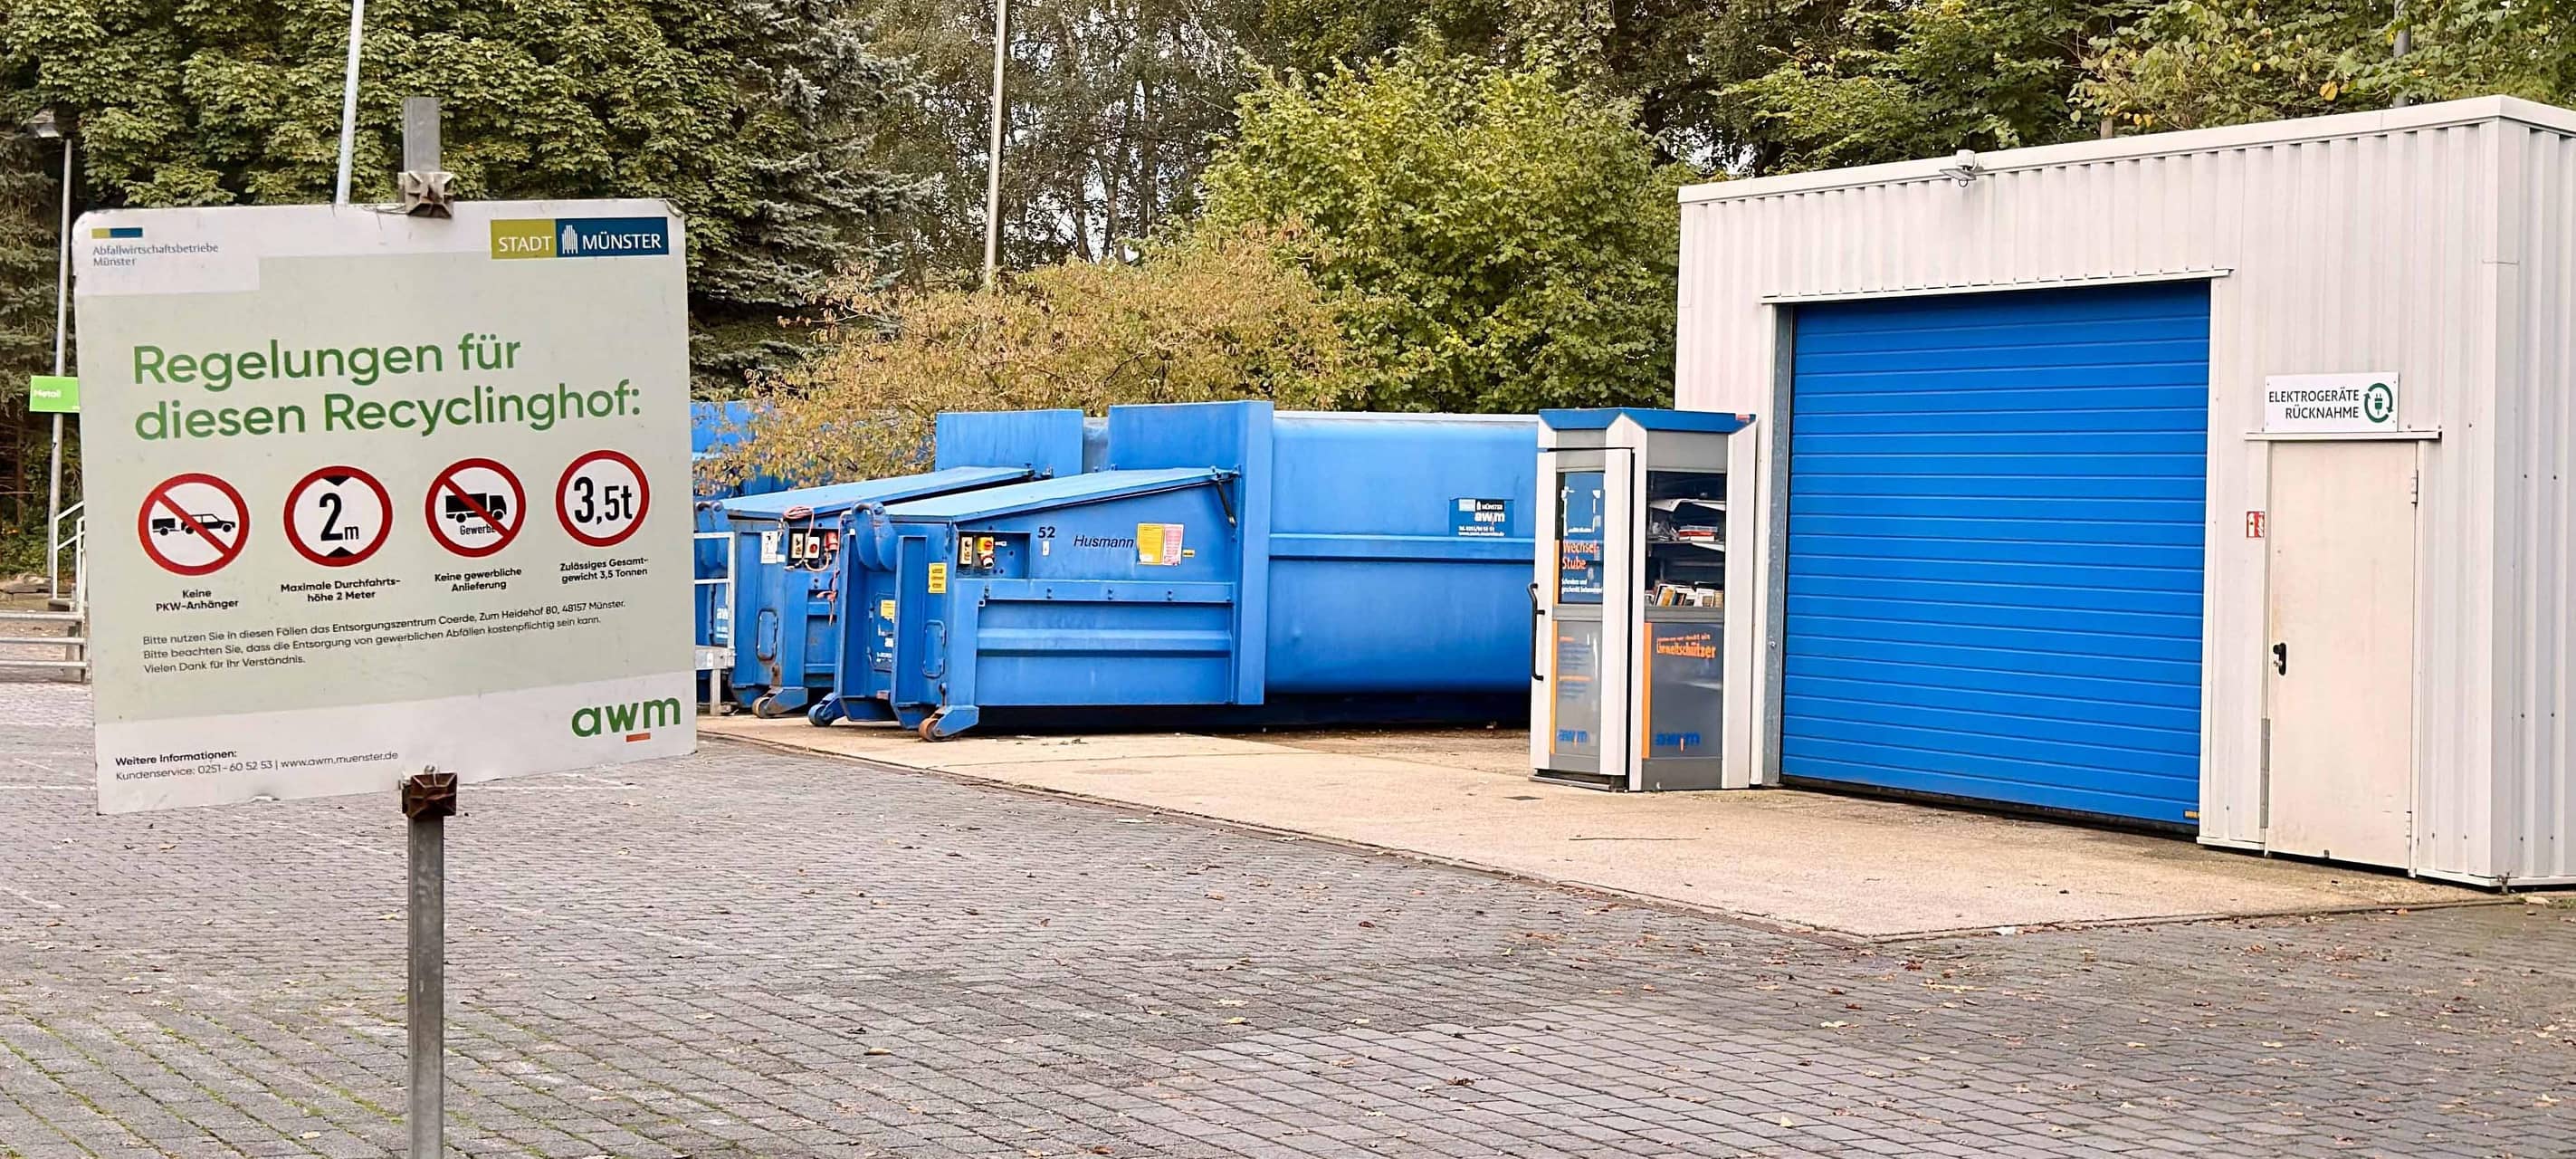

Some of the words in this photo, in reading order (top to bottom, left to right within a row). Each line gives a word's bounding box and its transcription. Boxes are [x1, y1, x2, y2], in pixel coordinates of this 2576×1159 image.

[92, 243, 218, 255] Abfallwirtschaftsbetriebe
[499, 235, 553, 252] STADT
[582, 231, 662, 250] MÜNSTER
[93, 257, 137, 266] Münster
[134, 340, 443, 392] Regelungen
[458, 332, 521, 370] für
[2269, 387, 2360, 402] ELEKTROGERÄTE
[135, 400, 305, 440] diesen
[324, 379, 640, 436] Recyclinghof:
[2285, 404, 2360, 419] RÜCKNAHME
[574, 476, 633, 524] 3,5t
[1037, 526, 1055, 539] 52
[1073, 534, 1134, 549] Husmann
[559, 560, 606, 573] Zulässiges
[609, 557, 649, 568] Gesamt-
[1562, 556, 1587, 570] Stube
[434, 572, 462, 582] Keine
[464, 568, 522, 581] gewerbliche
[561, 572, 598, 584] gewicht
[600, 570, 614, 580] 3,5
[615, 567, 648, 578] Tonnen
[281, 581, 332, 593] Maximale
[334, 578, 401, 589] Durchfahrts-
[452, 580, 507, 592] Anlieferung
[182, 589, 212, 599] Keine
[308, 592, 333, 602] höhe
[337, 592, 342, 601] 2
[346, 590, 376, 600] Meter
[156, 599, 239, 612] PKW-Anhänger
[143, 636, 167, 645] Bitte
[170, 633, 206, 643] nutzen
[208, 632, 224, 641] Sie
[227, 631, 237, 639] in
[239, 629, 273, 638] diesen
[276, 627, 308, 637] Fällen
[310, 625, 330, 634] das
[332, 618, 436, 632] Entsorgungszentrum
[438, 614, 477, 625] Coerde,
[479, 612, 500, 621] Zum
[501, 607, 544, 618] Heidehof
[546, 605, 560, 615] 80,
[562, 602, 587, 612] 48157
[589, 600, 625, 610] Münster.
[144, 650, 168, 659] Bitte
[171, 647, 223, 657] beachten
[224, 645, 243, 654] Sie,
[245, 643, 271, 653] dass
[273, 641, 291, 651] die
[292, 638, 351, 649] Entsorgung
[354, 637, 373, 646] von
[376, 631, 444, 645] gewerblichen
[446, 627, 485, 637] Abfällen
[488, 619, 555, 633] kostenpflichtig
[557, 618, 575, 627] sein
[577, 616, 601, 625] kann.
[144, 664, 177, 674] Vielen
[179, 661, 207, 671] Dank
[210, 660, 224, 669] für
[226, 659, 240, 668] Ihr
[243, 655, 306, 667] Verständnis.
[572, 697, 681, 737] awm
[115, 756, 157, 766] Weitere
[160, 751, 237, 762] Informationen:
[116, 768, 196, 781] Kundenservice:
[245, 761, 258, 771] 52
[261, 761, 273, 770] 53
[281, 752, 398, 768] www.awm.muenster.de
